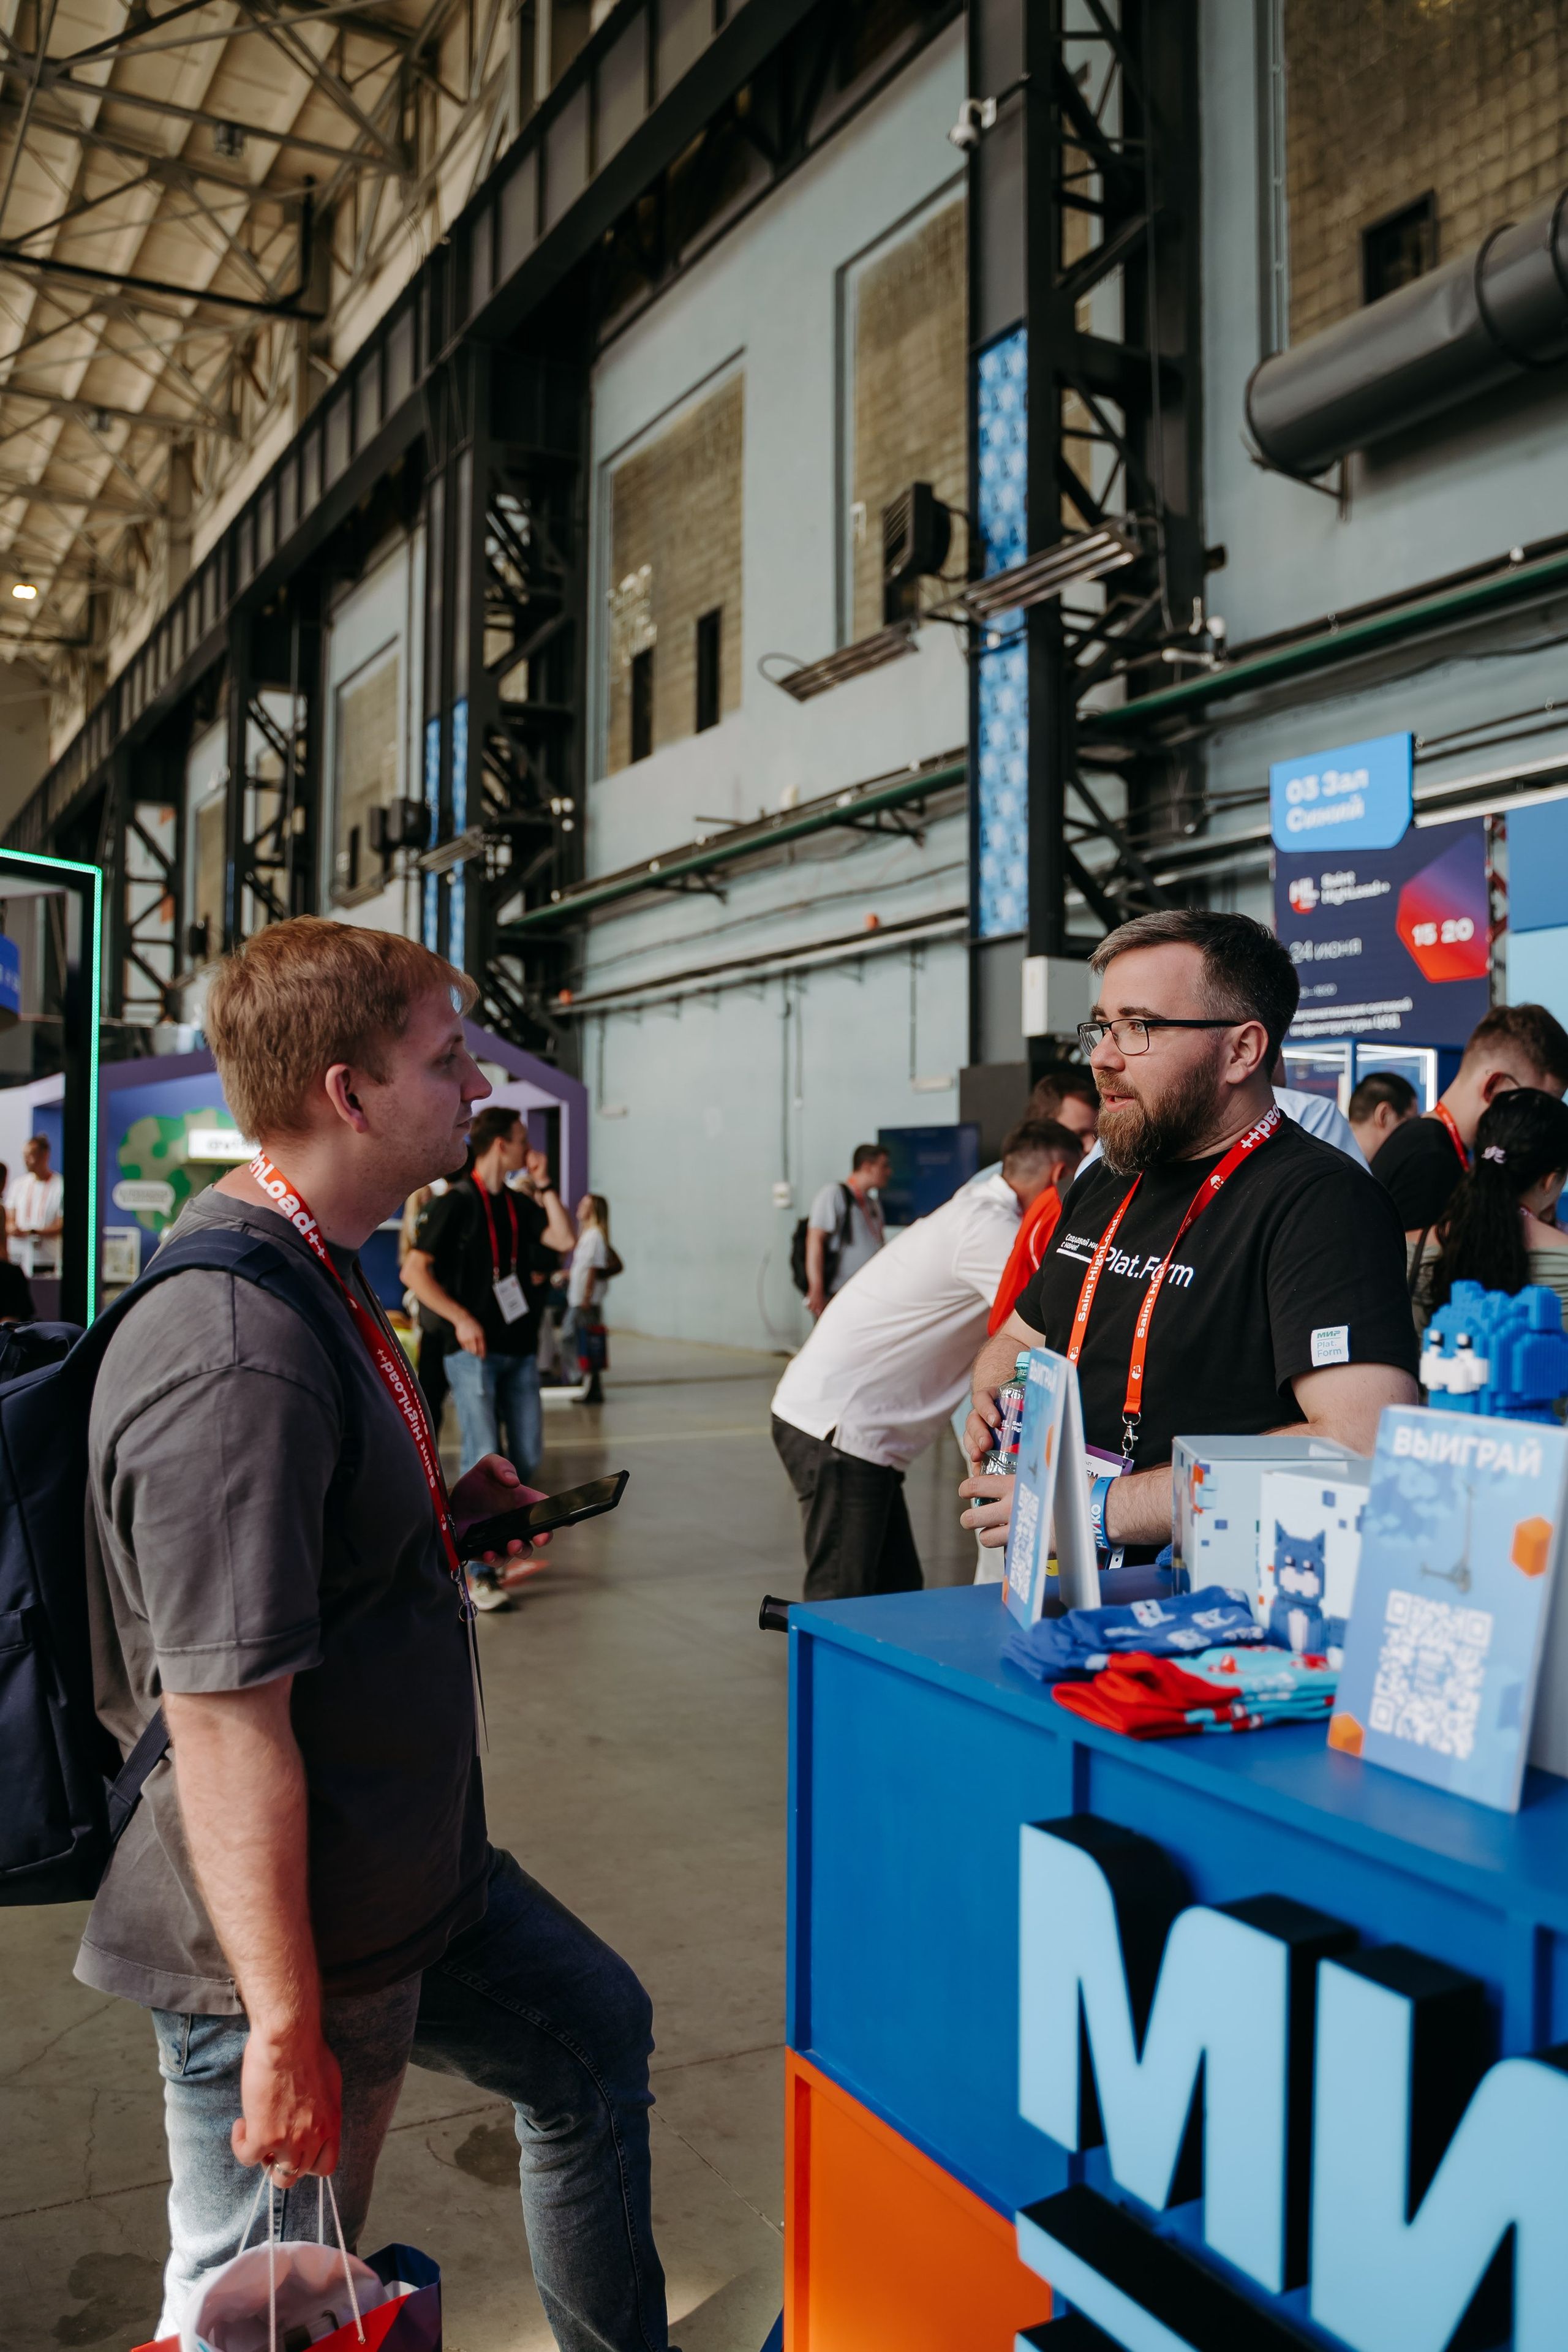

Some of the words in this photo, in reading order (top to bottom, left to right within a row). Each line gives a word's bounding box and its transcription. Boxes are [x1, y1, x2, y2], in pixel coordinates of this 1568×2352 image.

[1321, 768, 1370, 797] Зал
[1286, 793, 1365, 832] Синий
[1065, 1233, 1090, 1247] Создавай
[1078, 1283, 1094, 1322] Saint
[1088, 1208, 1124, 1281] HighLoad++
[1137, 1297, 1154, 1338] Saint
[1317, 1348, 1342, 1358] Form
[377, 1348, 423, 1441] HighLoad++
[420, 1441, 435, 1488] Saint
[1392, 1426, 1543, 1477] ВЫИГРАЙ
